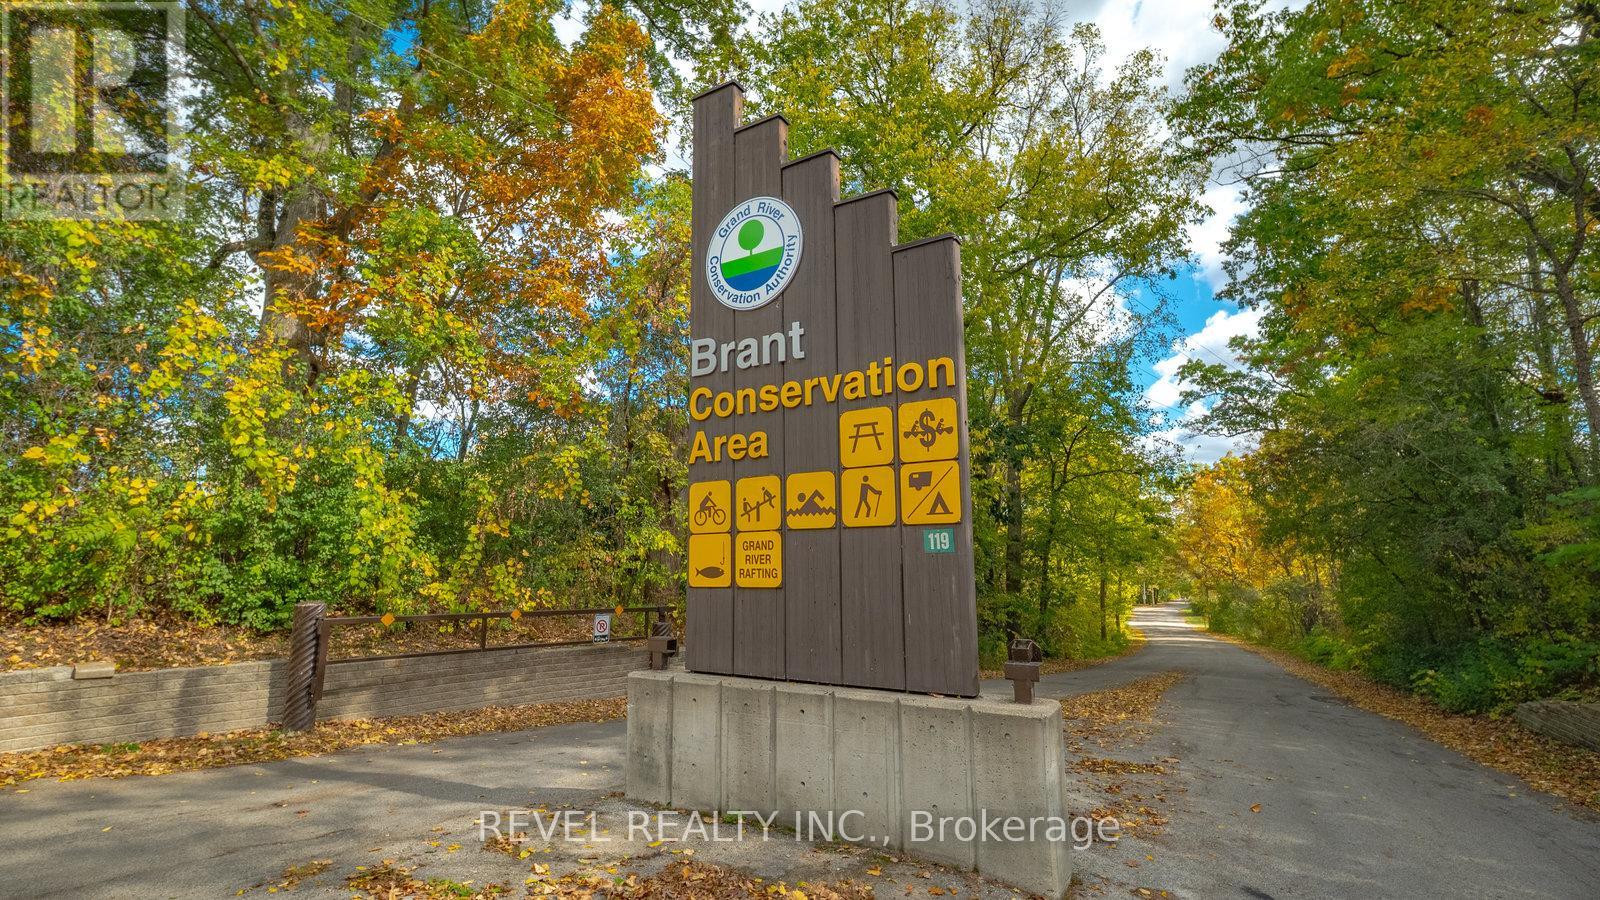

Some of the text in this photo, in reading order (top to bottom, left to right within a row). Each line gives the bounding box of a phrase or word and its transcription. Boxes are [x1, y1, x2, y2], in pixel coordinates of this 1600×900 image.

[718, 201, 785, 240] Grand River
[709, 234, 798, 304] Conservation Authority
[691, 321, 805, 377] Brant
[689, 356, 956, 421] Conservation
[688, 430, 769, 464] Area
[742, 540, 774, 551] GRAND
[927, 532, 950, 550] 119
[739, 568, 778, 579] RAFTING
[745, 554, 772, 565] RIVER
